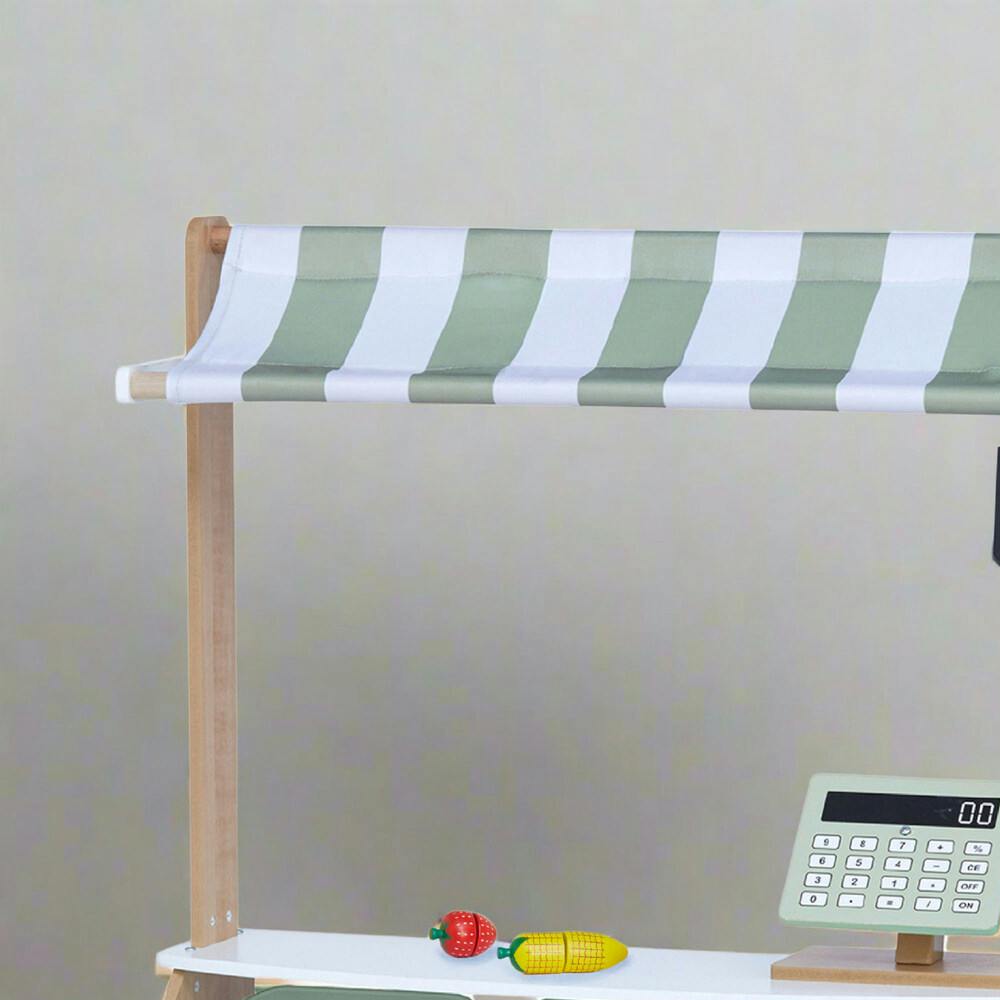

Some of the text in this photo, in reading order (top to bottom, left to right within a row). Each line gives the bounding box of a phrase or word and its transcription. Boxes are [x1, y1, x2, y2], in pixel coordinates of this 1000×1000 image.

[958, 801, 995, 825] 00
[823, 838, 830, 847] 9
[859, 839, 866, 848] 8
[899, 841, 906, 850] 7
[818, 856, 826, 865] 6
[855, 858, 863, 867] 5
[814, 876, 821, 884] 3
[851, 877, 858, 886] 2
[810, 895, 817, 903] 0
